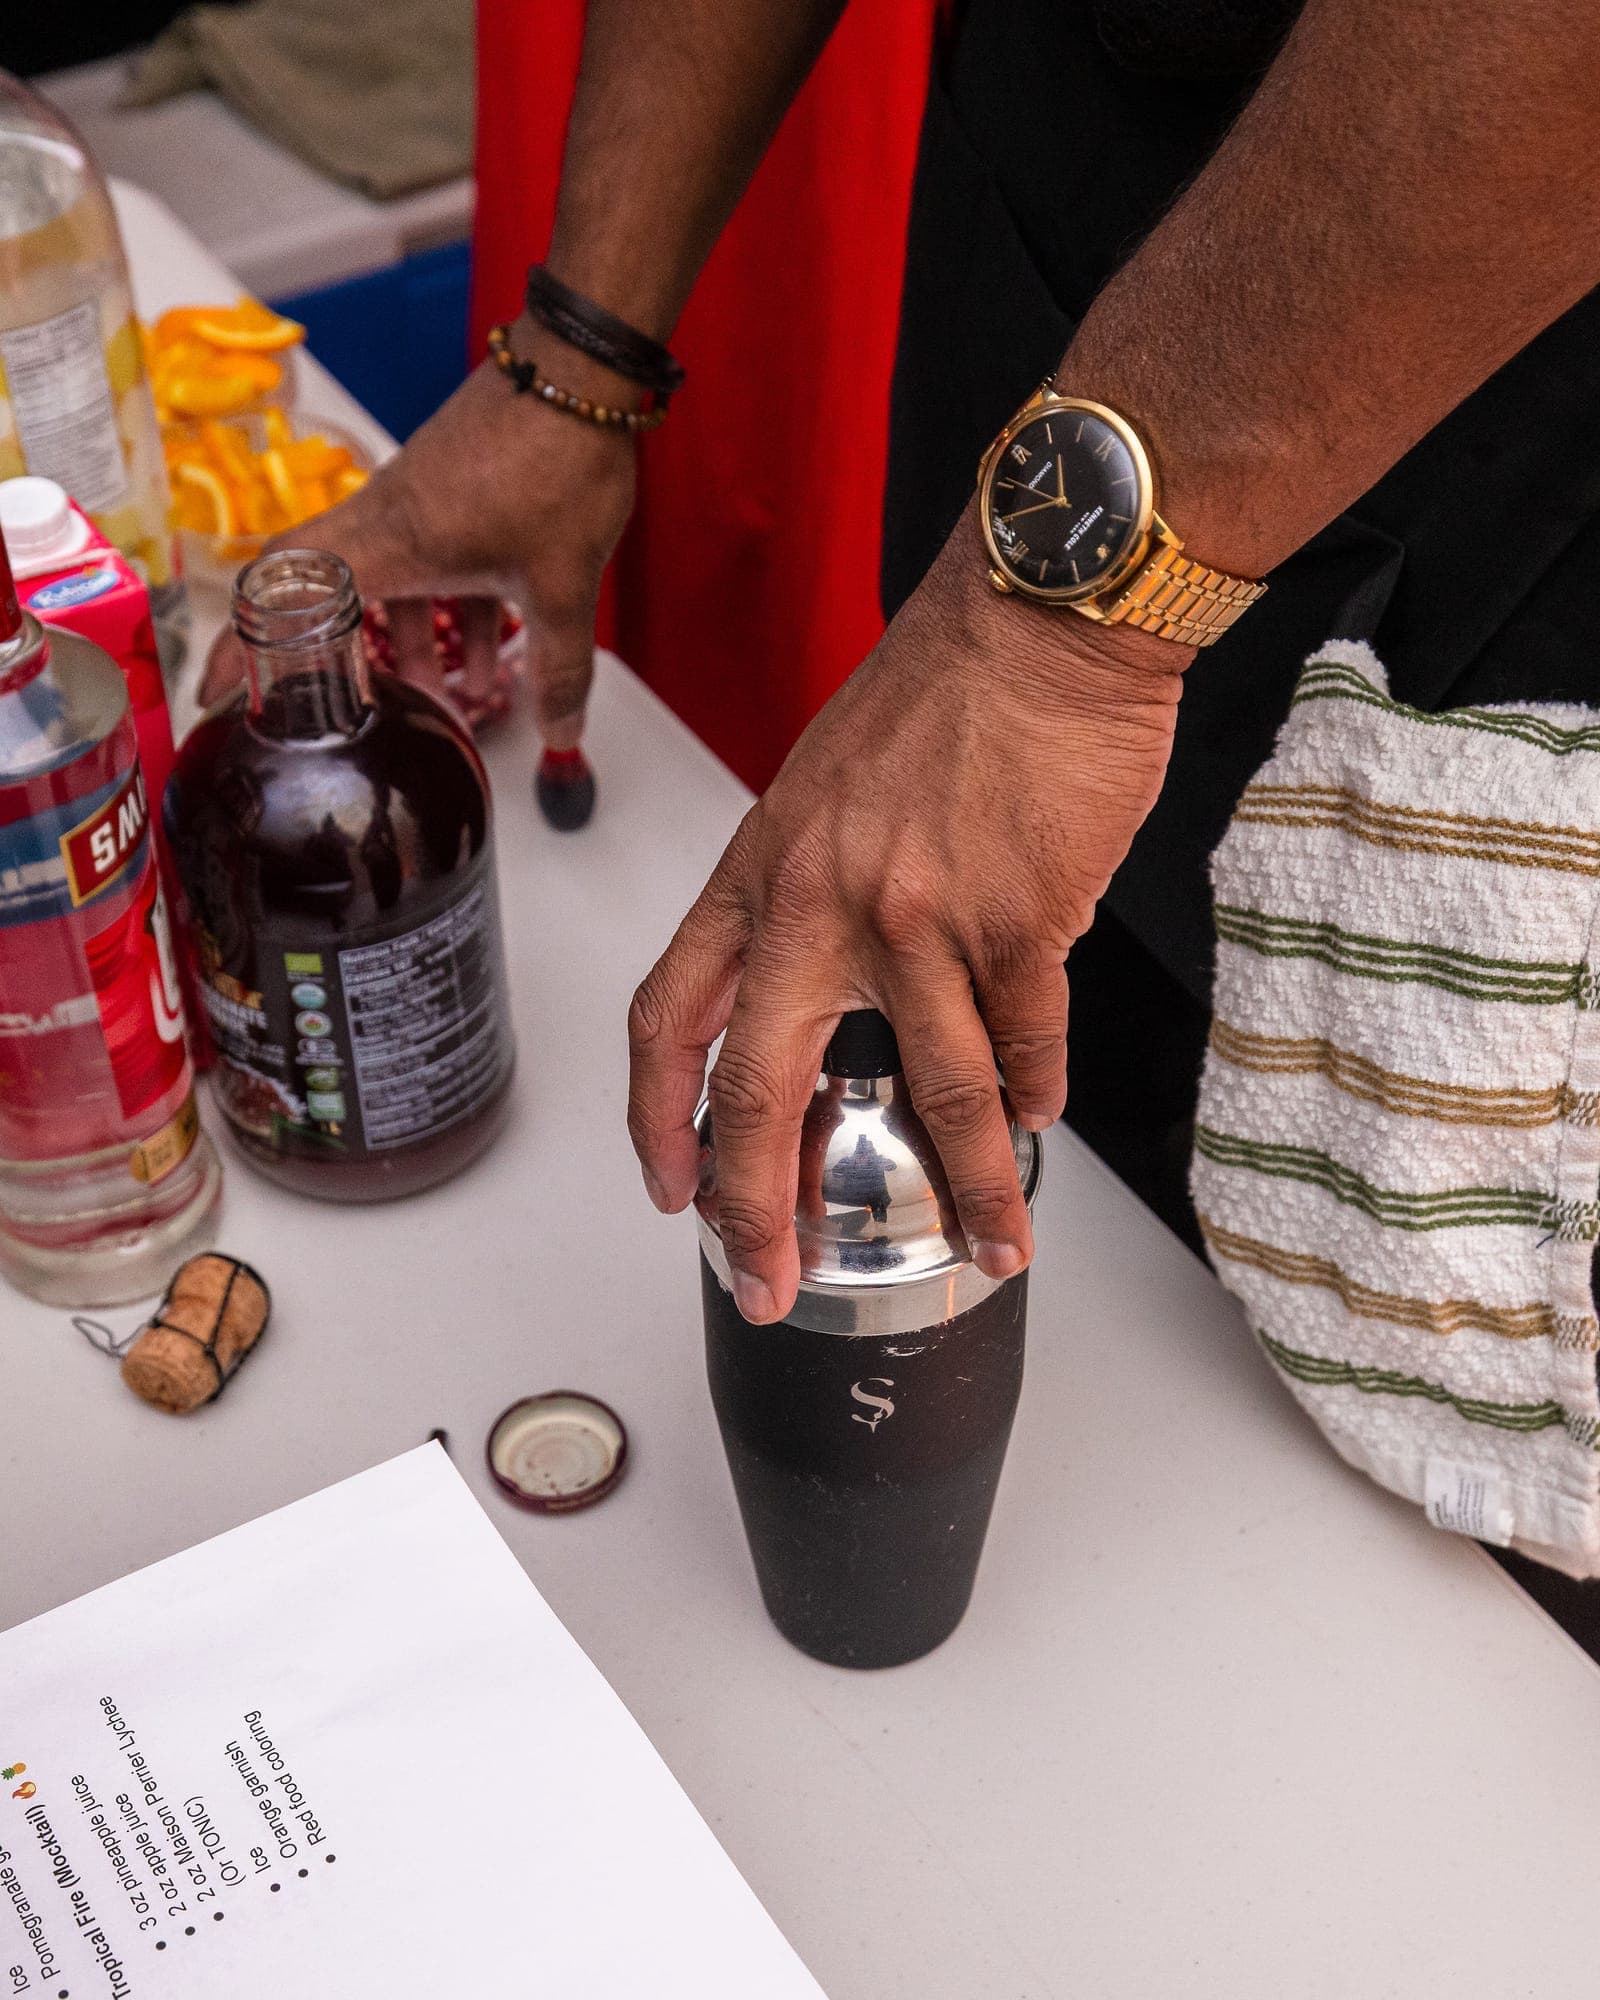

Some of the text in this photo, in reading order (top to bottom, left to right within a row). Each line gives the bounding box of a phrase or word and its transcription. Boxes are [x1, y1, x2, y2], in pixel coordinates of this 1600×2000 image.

[1028, 461, 1053, 489] DIAMOND
[1063, 505, 1104, 552] KENNETH COLE
[100, 1696, 215, 1902] 2 oz Maison Perrier Lychee
[224, 1741, 297, 1858] Orange garnish
[244, 1711, 326, 1846] Red food coloring
[72, 1775, 157, 1930] 3 oz pineapple juice
[116, 1793, 187, 1916] 2 oz apple juice
[184, 1796, 246, 1886] (Or TONIC)
[250, 1847, 271, 1874] Ice
[0, 1867, 61, 1980] Pomegranate
[25, 1805, 131, 2000] Tropical Fire (Mocktail)
[9, 1965, 31, 1994] Ice
